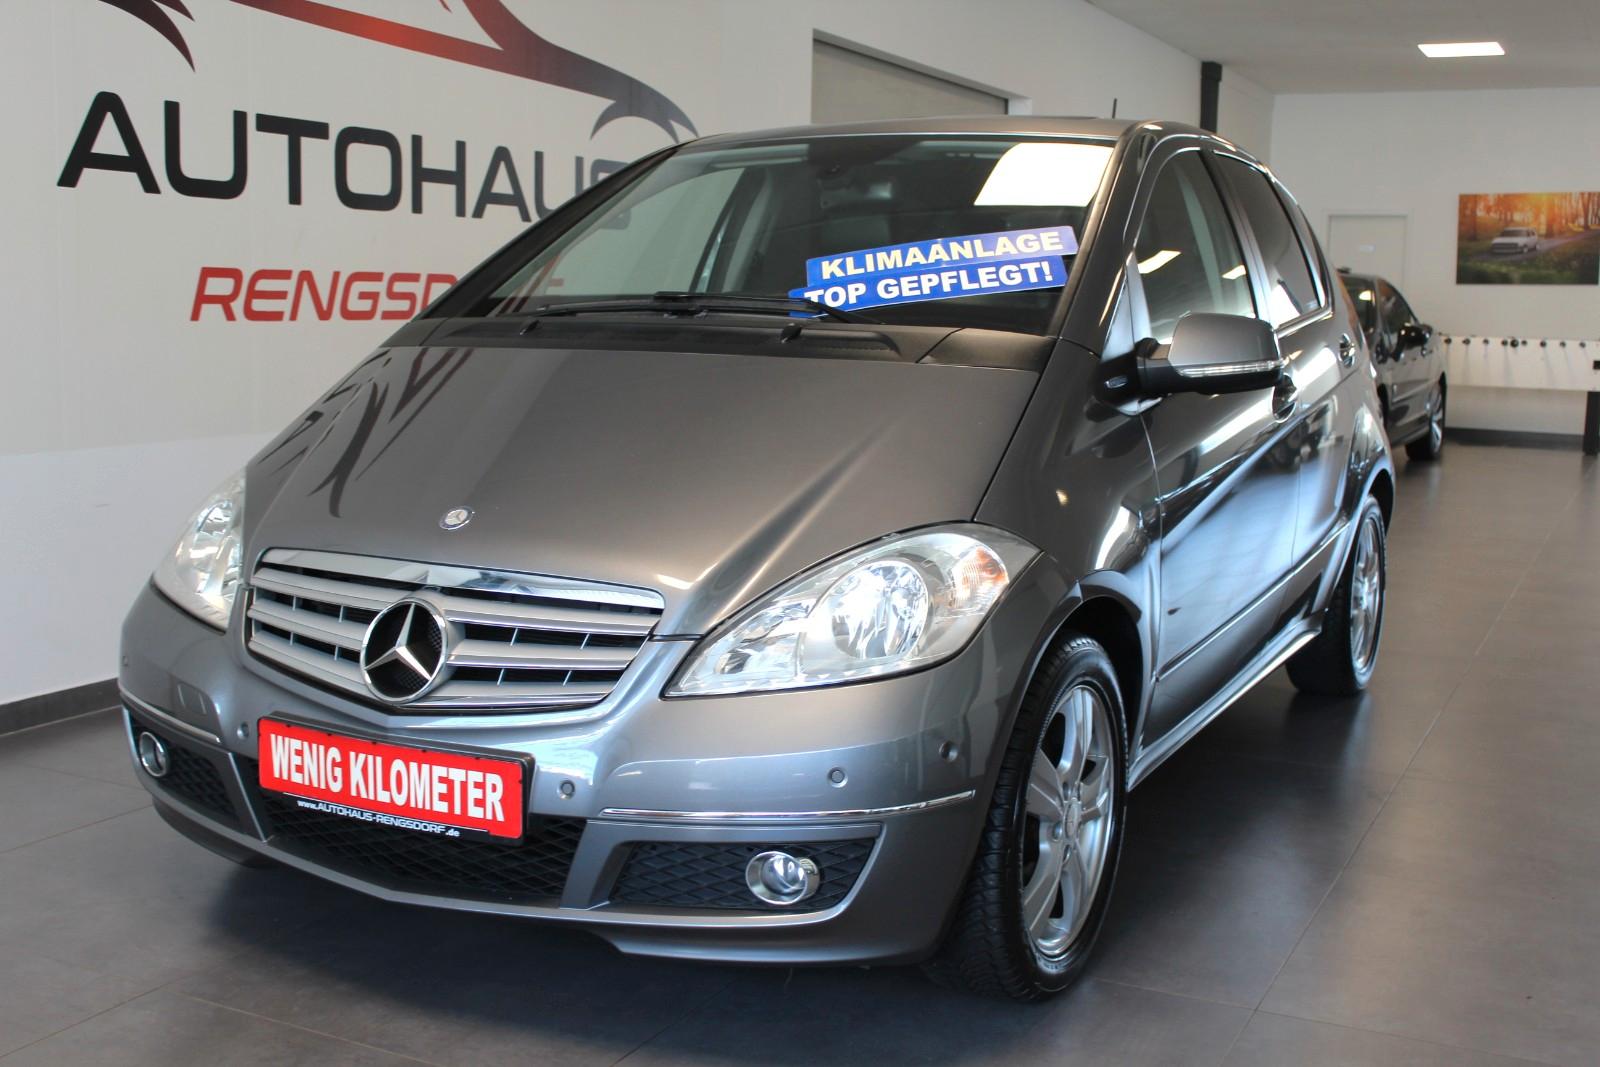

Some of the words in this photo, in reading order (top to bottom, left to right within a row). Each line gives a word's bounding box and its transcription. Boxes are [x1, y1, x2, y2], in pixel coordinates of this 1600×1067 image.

[821, 231, 1064, 280] KLIMAANLAGE
[803, 283, 867, 308] TOP
[876, 261, 1053, 299] GEPFLEGT!
[270, 733, 343, 793] WENIG
[349, 751, 505, 822] KILOMETER
